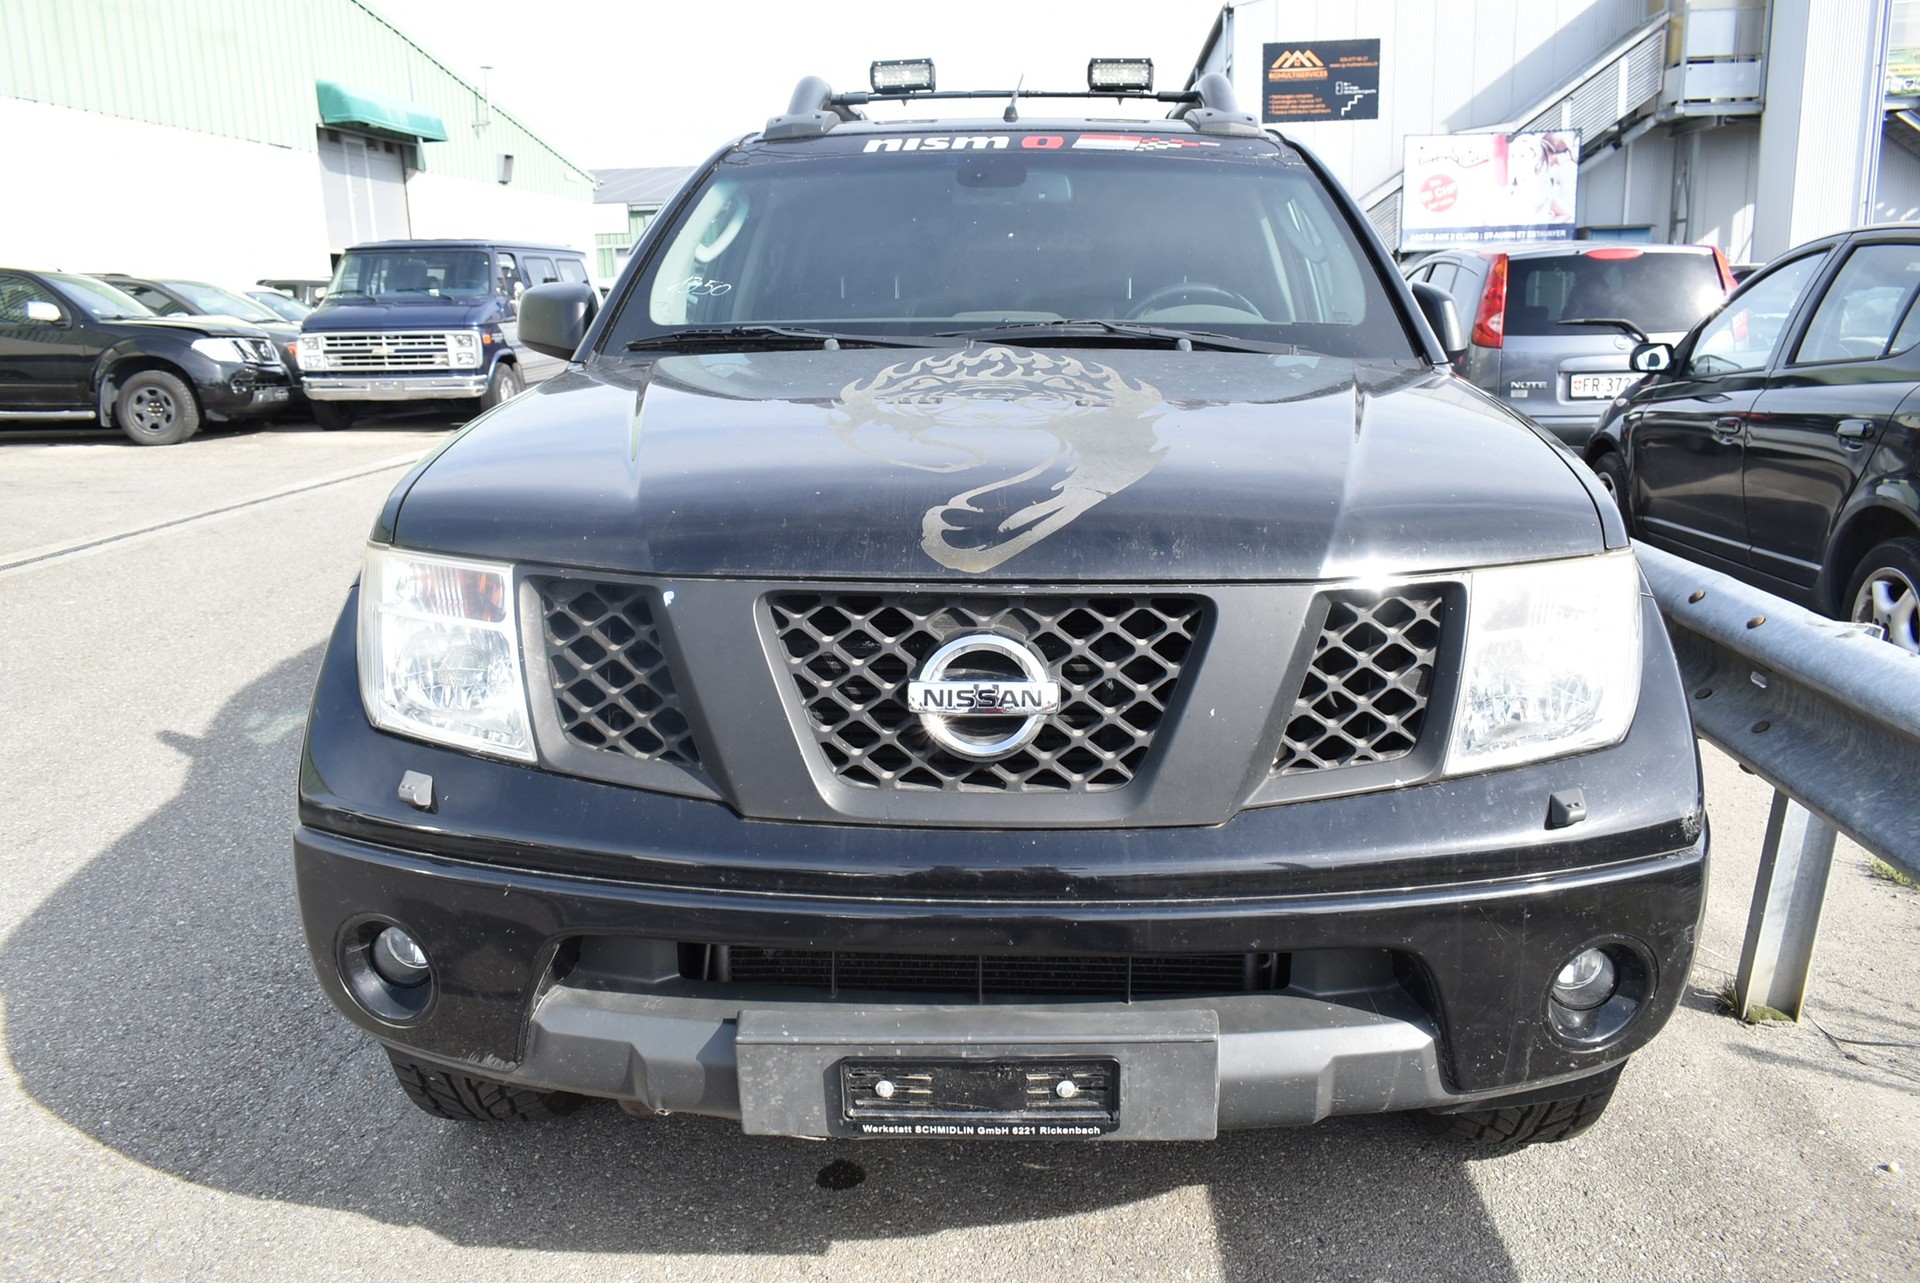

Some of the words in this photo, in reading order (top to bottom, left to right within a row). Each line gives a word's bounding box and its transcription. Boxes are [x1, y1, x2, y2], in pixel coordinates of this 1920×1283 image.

[1510, 381, 1547, 389] NOTE
[1583, 378, 1600, 392] FR
[1606, 377, 1641, 392] 372
[923, 689, 1042, 708] NISSAN
[863, 1124, 912, 1134] Werkstatt
[915, 1125, 974, 1135] SCHMIDLIN
[978, 1126, 1009, 1135] GmbH
[1012, 1126, 1036, 1135] 6221
[1040, 1126, 1100, 1135] Rickenbach
